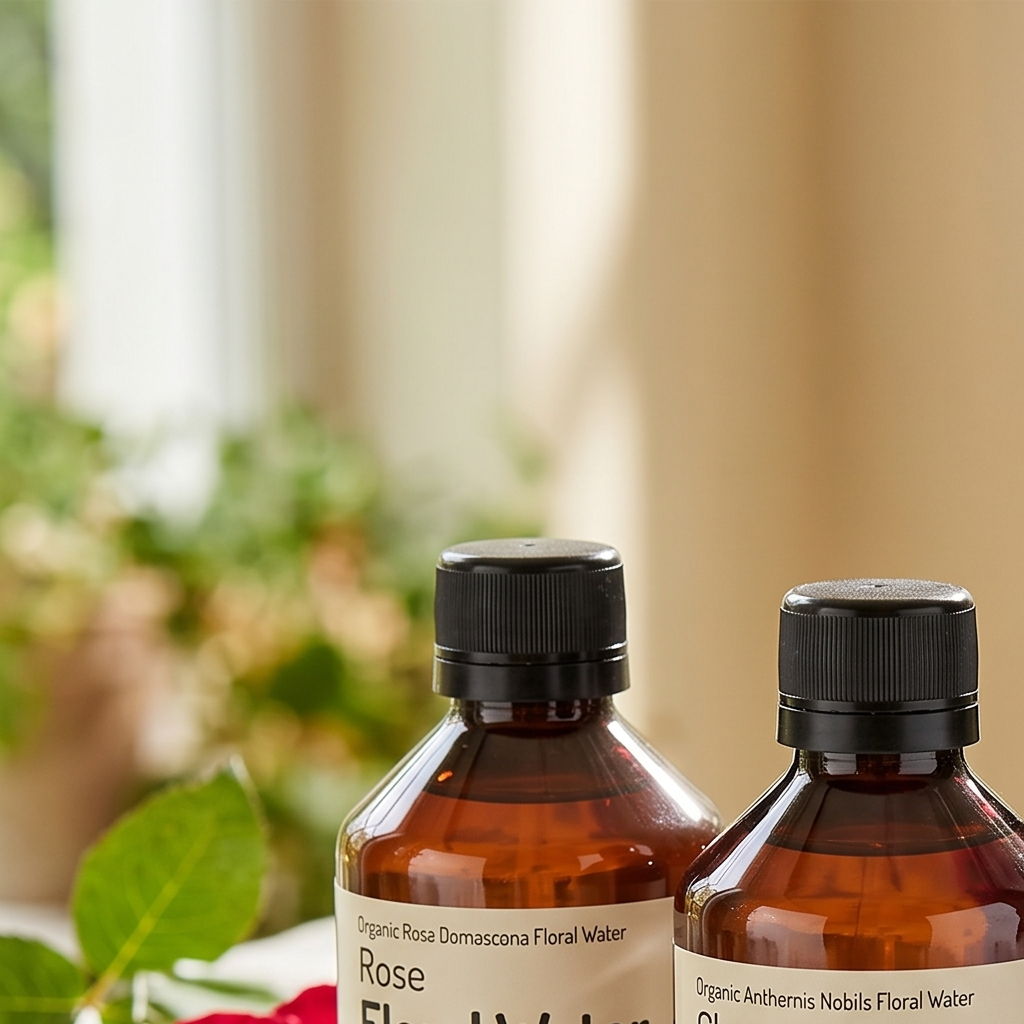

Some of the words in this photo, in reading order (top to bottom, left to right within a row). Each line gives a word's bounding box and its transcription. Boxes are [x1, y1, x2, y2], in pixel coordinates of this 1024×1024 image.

[358, 916, 399, 940] Organic
[534, 926, 577, 945] Floral
[582, 925, 626, 943] Water
[361, 947, 424, 991] Rose
[697, 977, 740, 1003] Organic
[877, 991, 922, 1010] Floral
[928, 990, 974, 1008] Water
